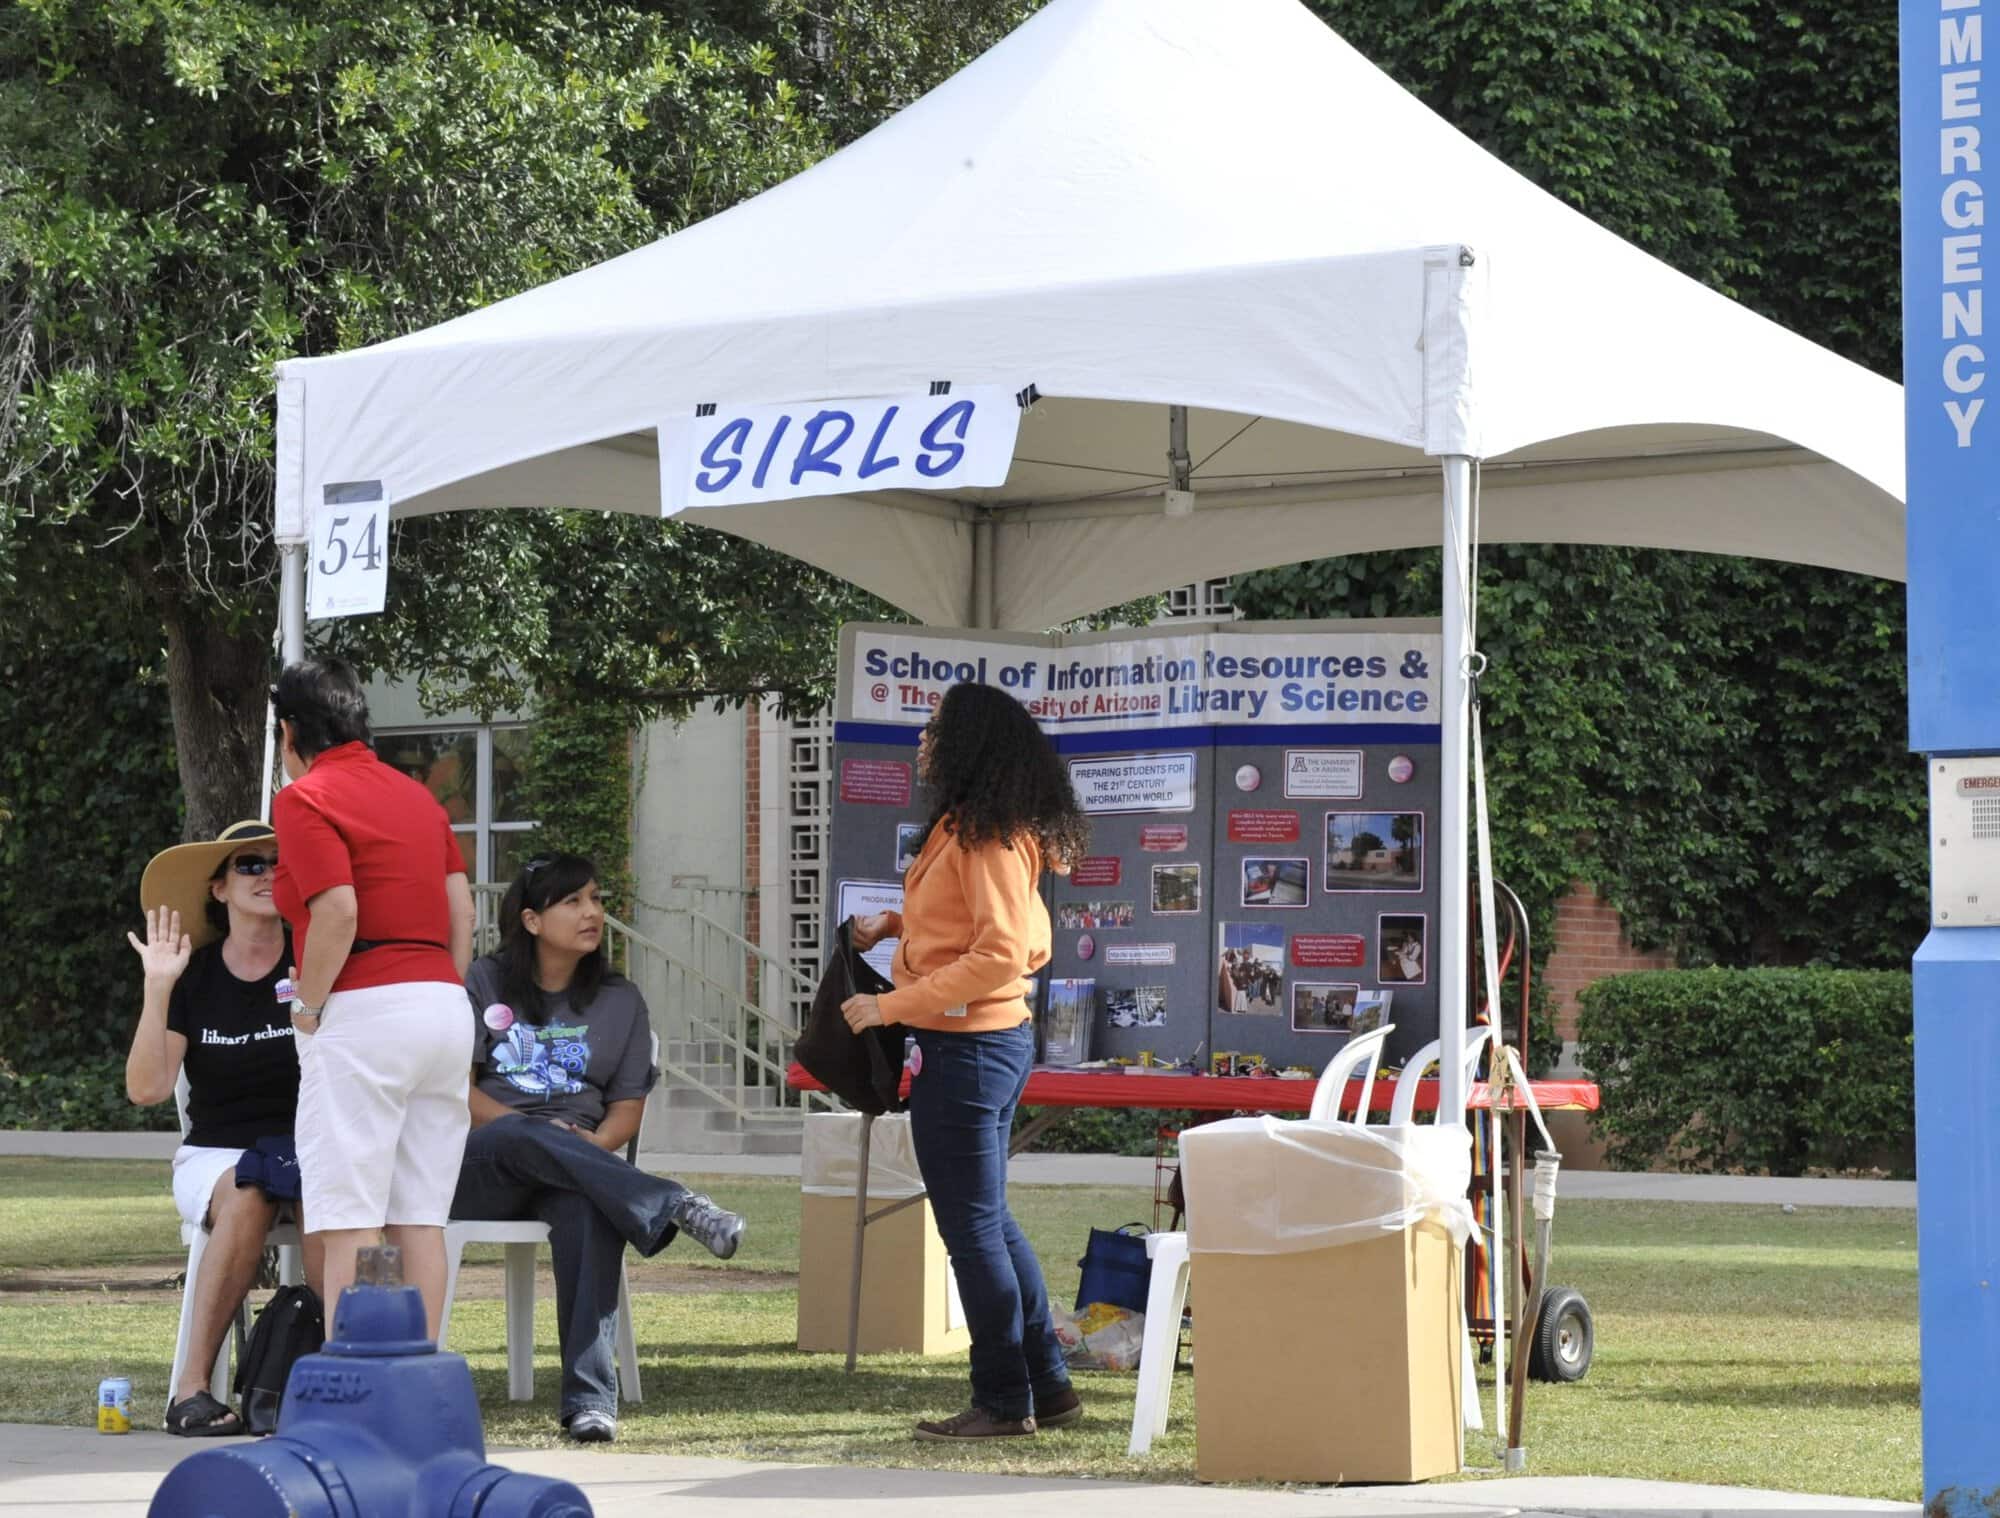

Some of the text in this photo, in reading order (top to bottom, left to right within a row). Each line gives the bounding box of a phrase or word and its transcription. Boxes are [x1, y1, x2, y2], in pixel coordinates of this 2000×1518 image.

[1940, 0, 1985, 448] MERGENCY
[695, 400, 975, 493] SIRLS
[319, 513, 382, 575] 54
[864, 648, 1429, 691] School of Information Resources &
[871, 683, 941, 706] @ The
[1070, 696, 1089, 715] of
[1094, 692, 1161, 714] Arizona
[1168, 683, 1429, 719] Library Science
[1076, 763, 1185, 779] PREPARING STUDENTS FOR
[1093, 781, 1109, 791] THE
[1127, 779, 1167, 789] CENTURY
[1964, 777, 2000, 789] EMERGE
[1086, 792, 1173, 804] INFORMATION WORLD
[200, 1024, 295, 1045] library schoo
